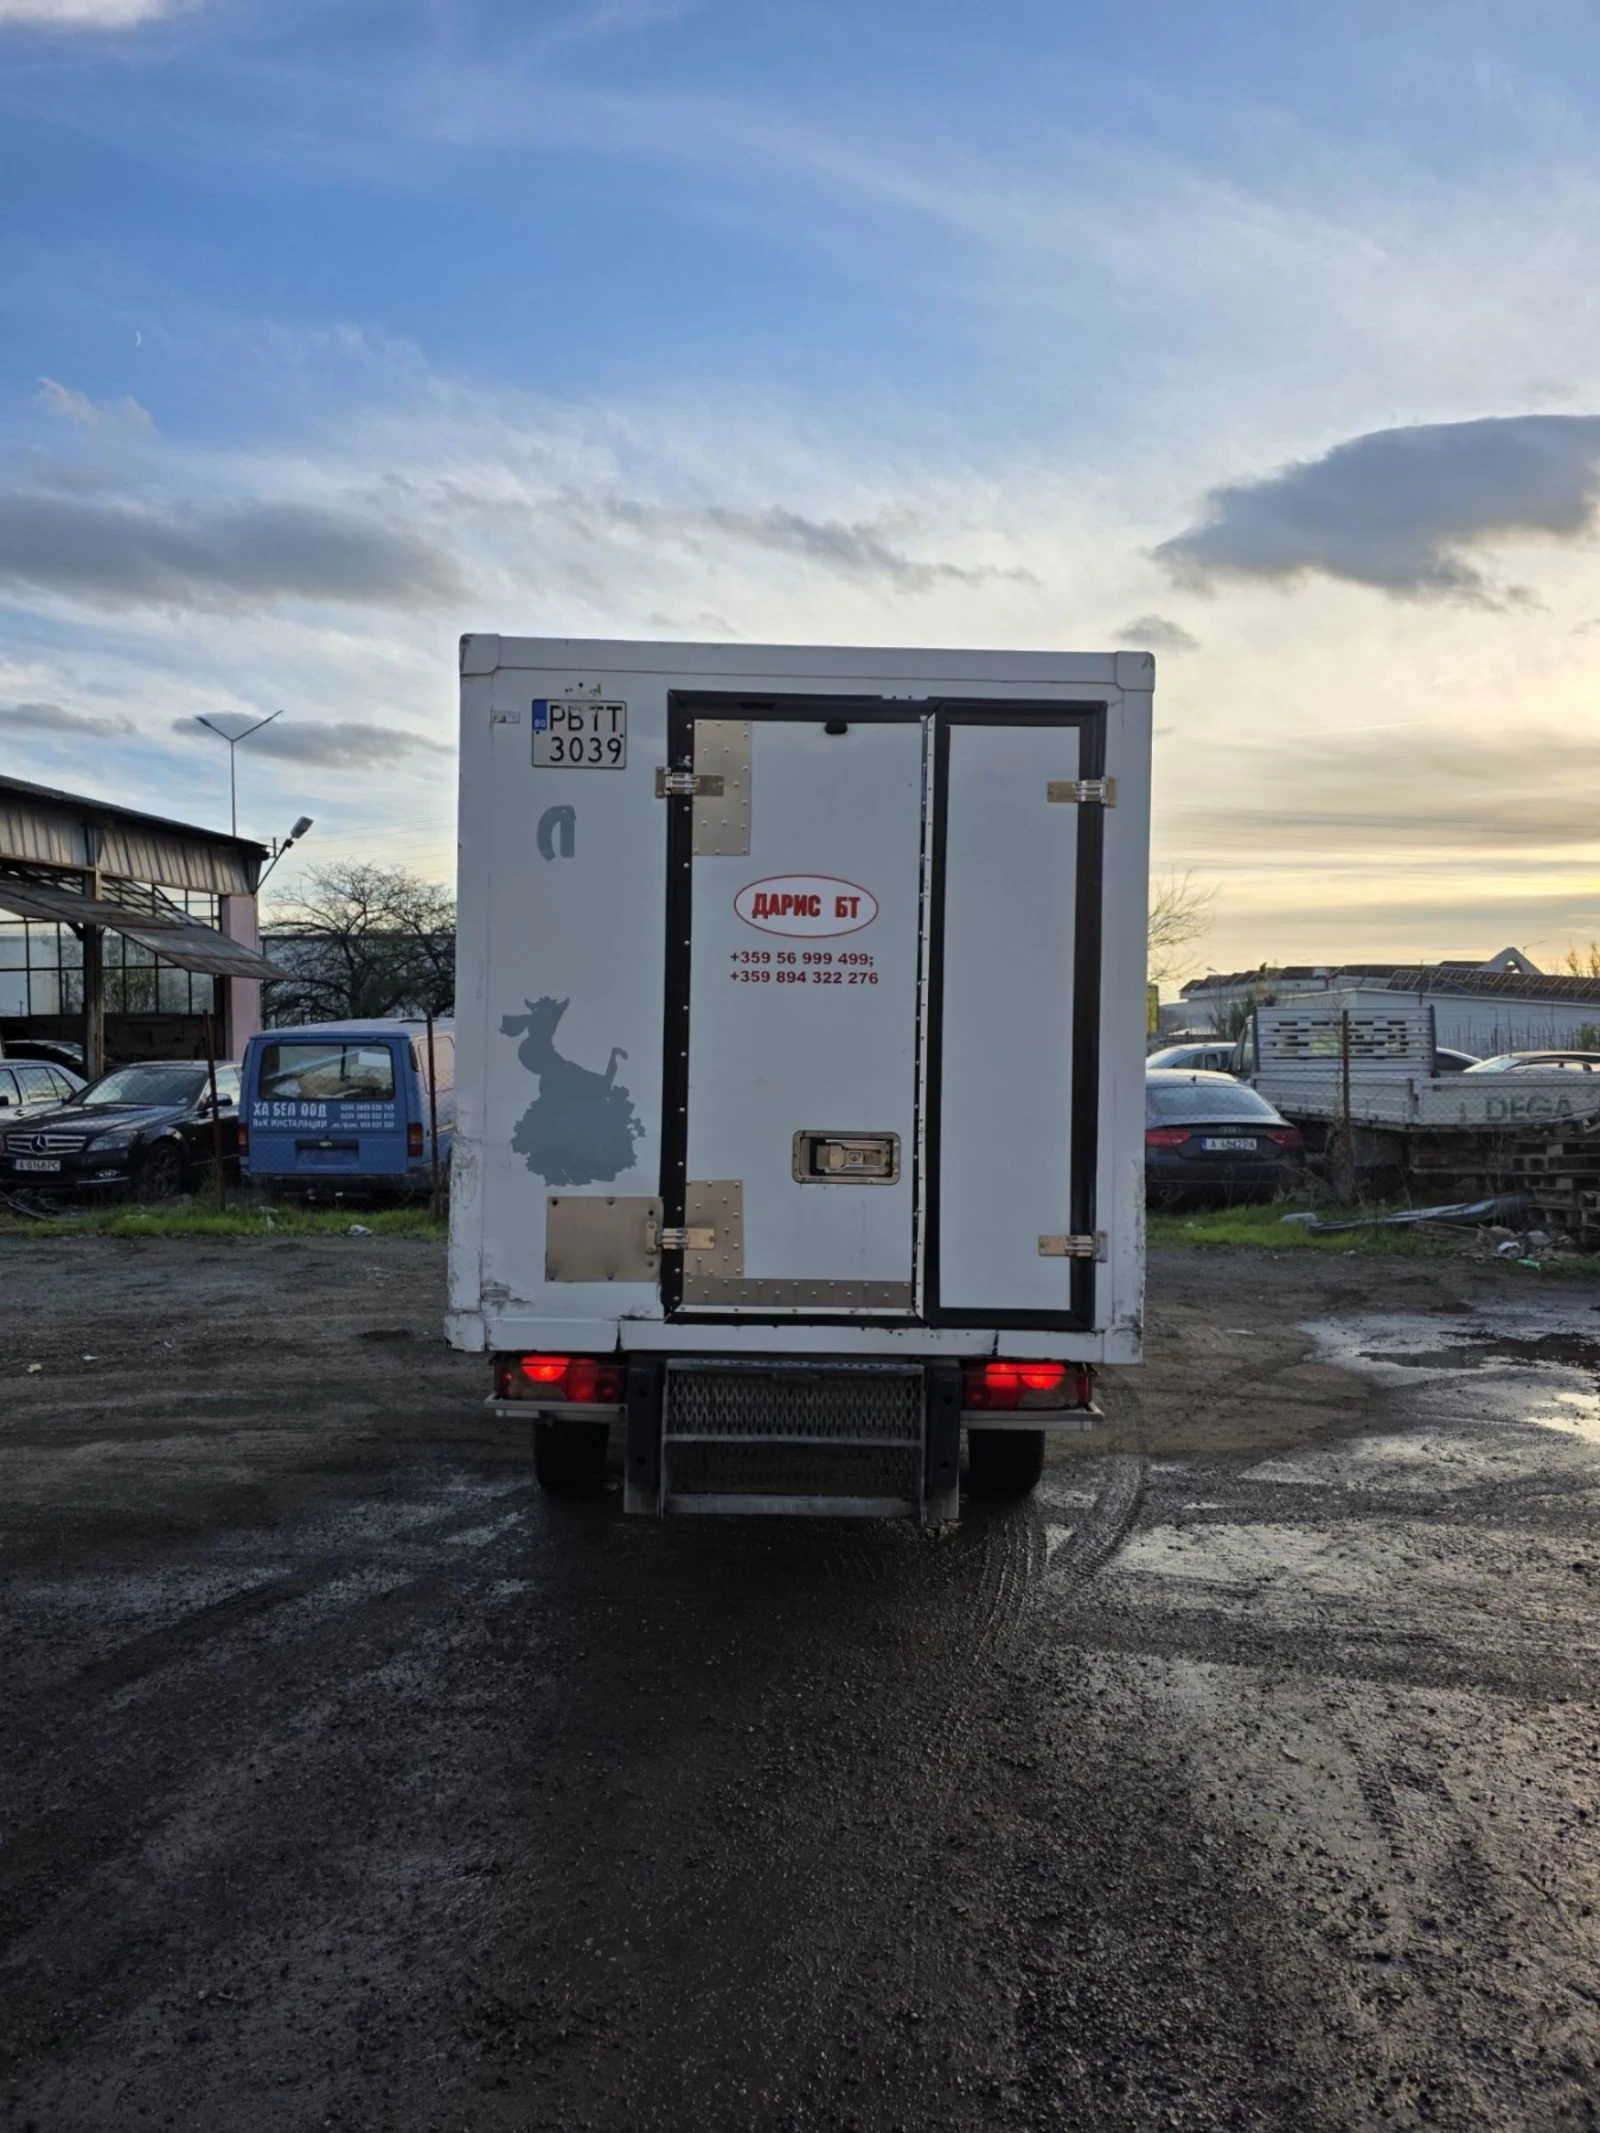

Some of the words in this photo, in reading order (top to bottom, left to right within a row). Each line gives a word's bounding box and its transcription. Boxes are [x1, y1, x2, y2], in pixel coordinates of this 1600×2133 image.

[549, 736, 622, 764] 3039
[752, 892, 821, 919] ДАРИС
[835, 896, 861, 919] БТ
[730, 951, 771, 964] +359
[776, 952, 796, 965] 56
[802, 952, 832, 965] 999
[838, 953, 874, 967] 499;
[730, 970, 771, 983] +359
[776, 971, 806, 983] 894
[812, 971, 842, 984] 322
[847, 972, 878, 985] 276
